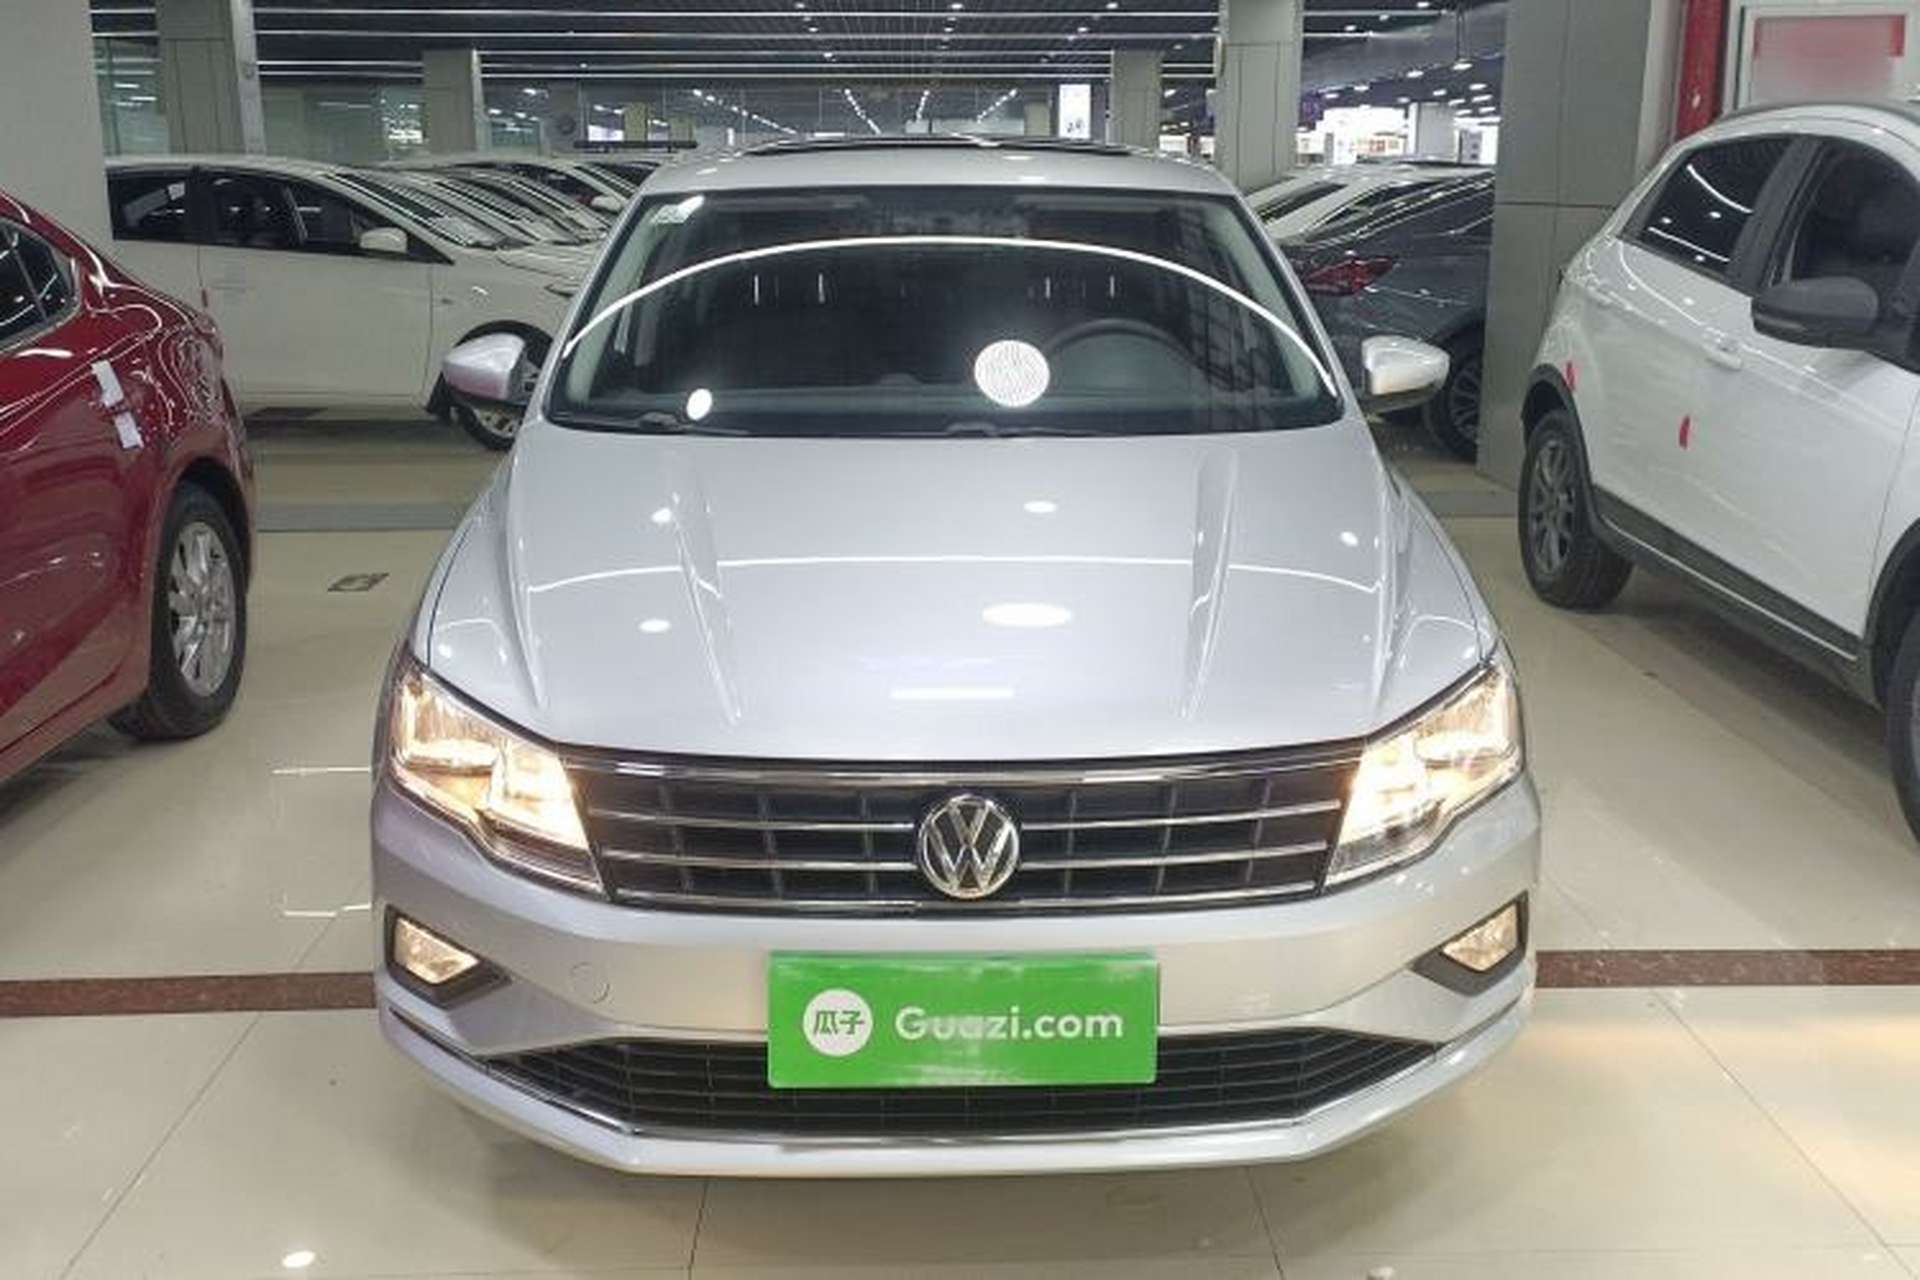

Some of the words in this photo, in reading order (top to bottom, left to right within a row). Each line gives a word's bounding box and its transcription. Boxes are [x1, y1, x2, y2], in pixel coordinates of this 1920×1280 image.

[921, 796, 1018, 897] VW
[813, 1009, 865, 1035] 瓜子
[895, 1006, 1123, 1040] Guazi.com
